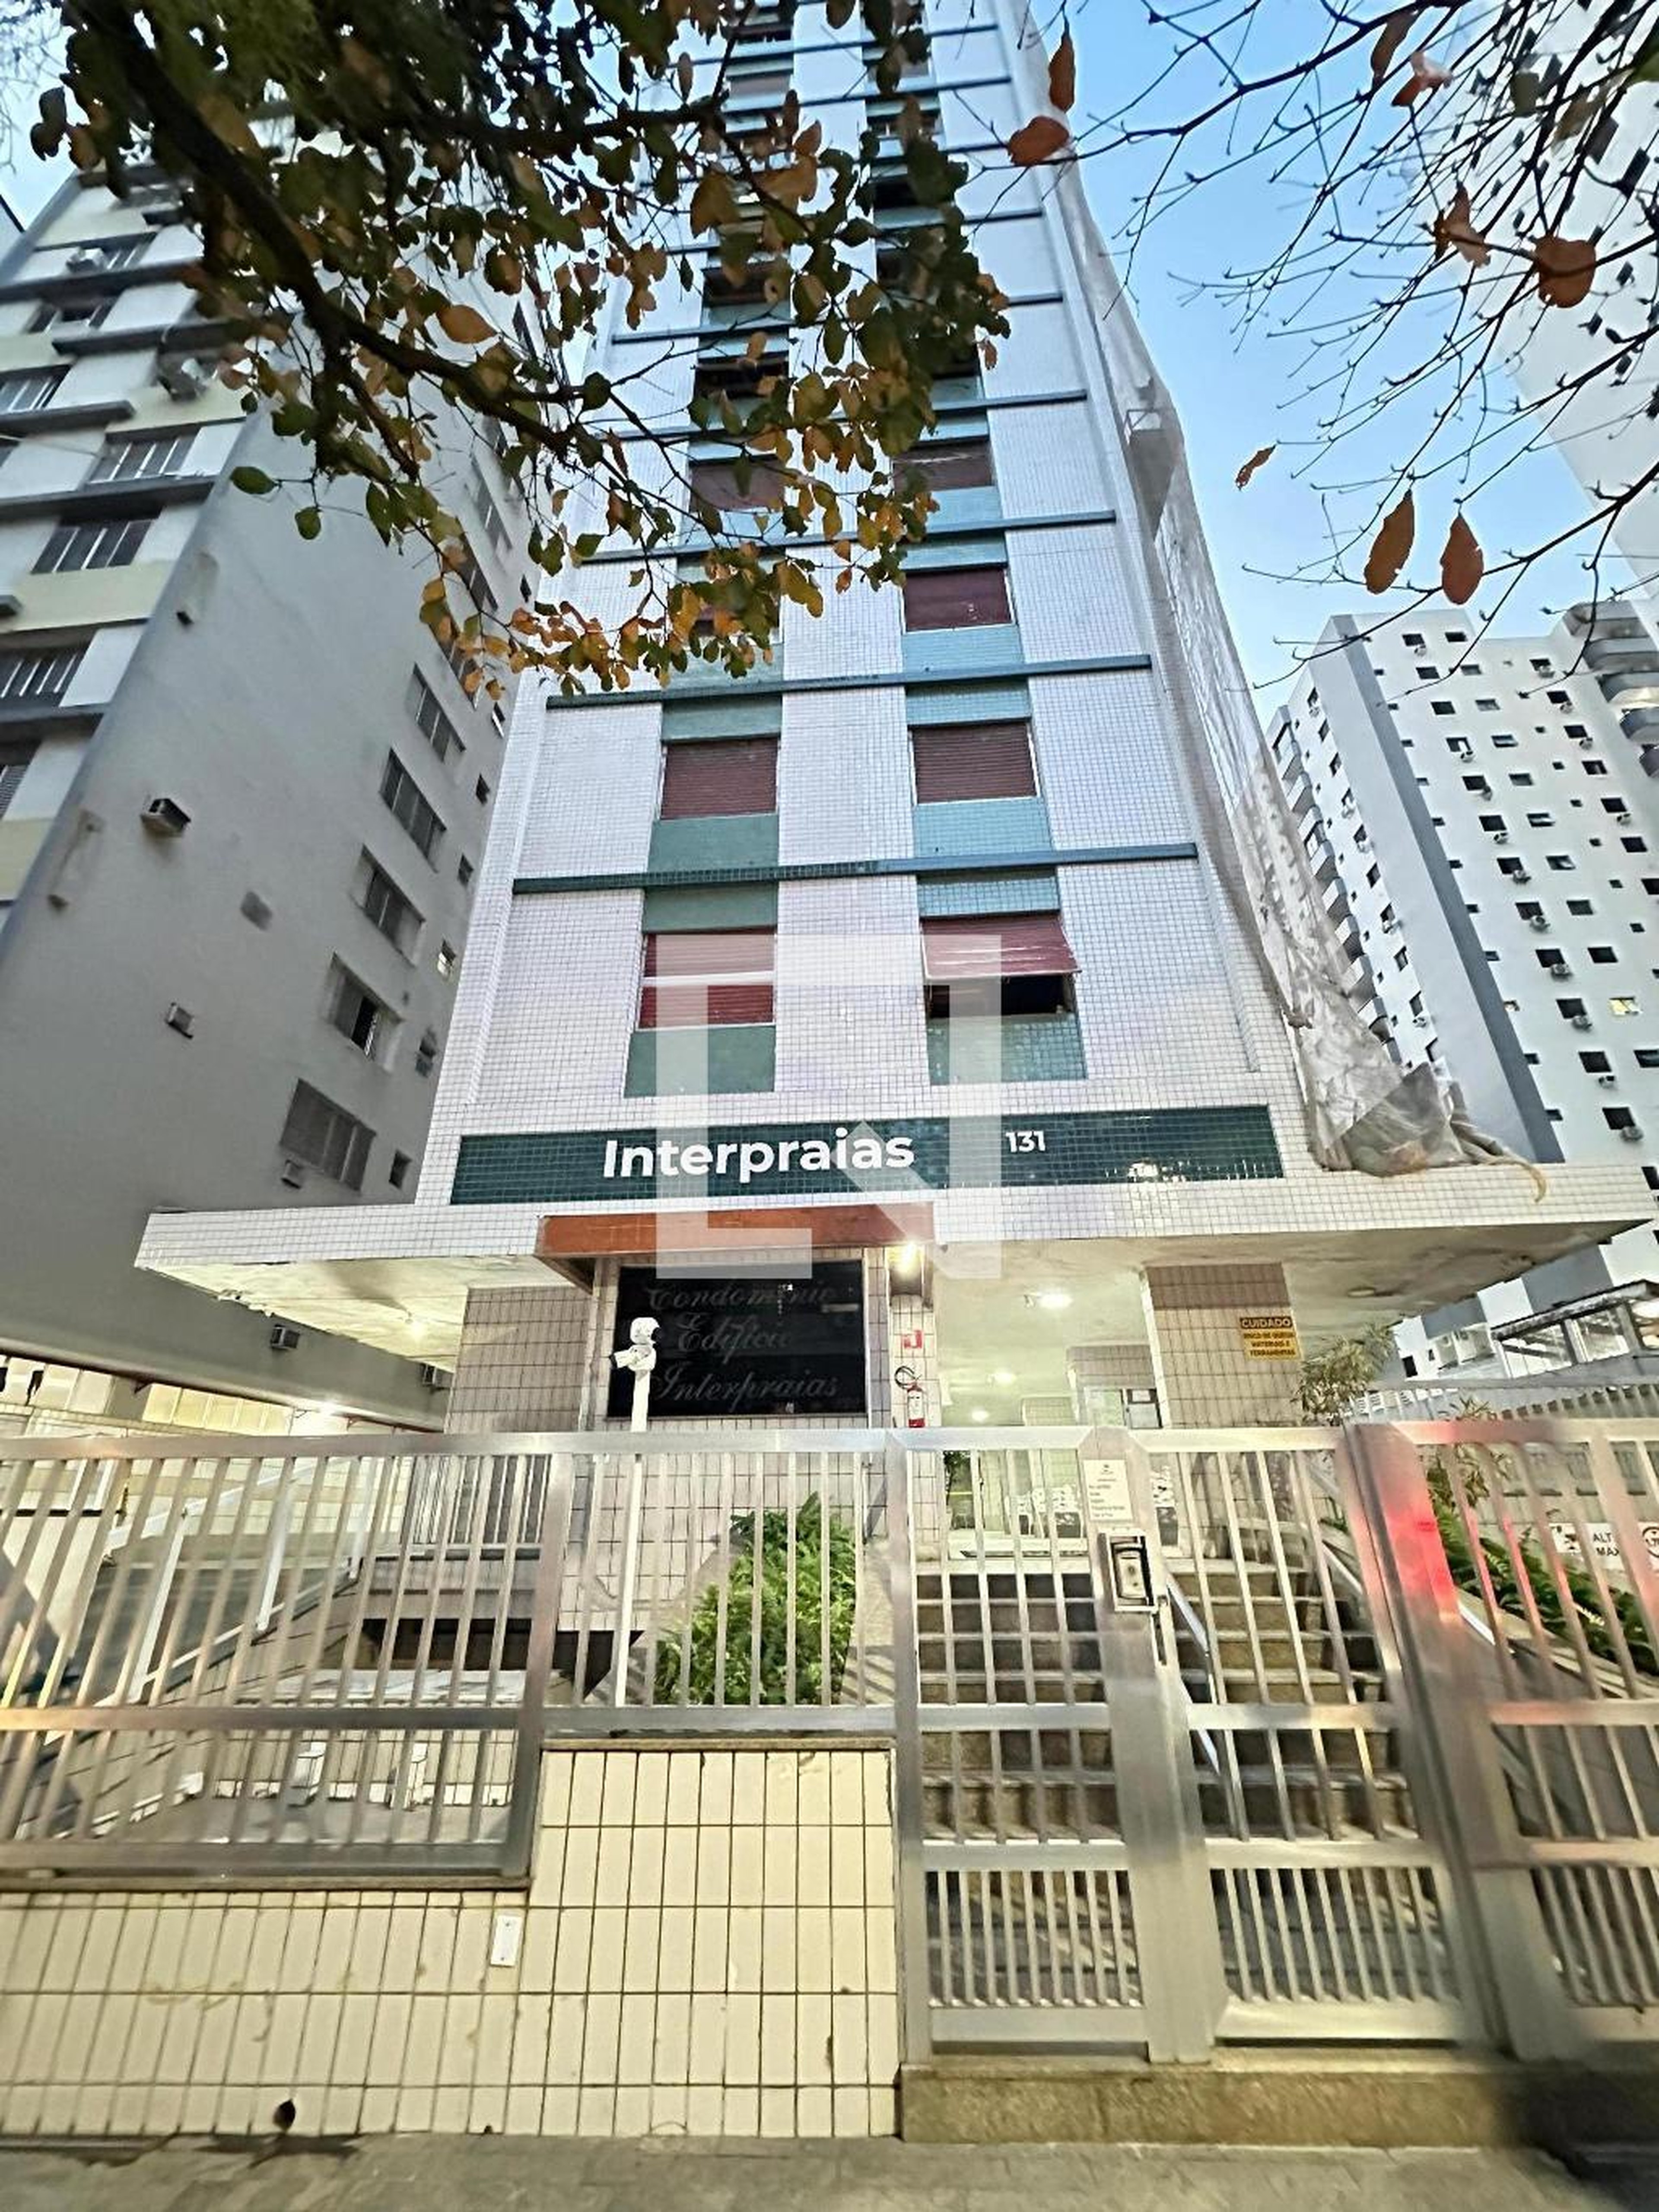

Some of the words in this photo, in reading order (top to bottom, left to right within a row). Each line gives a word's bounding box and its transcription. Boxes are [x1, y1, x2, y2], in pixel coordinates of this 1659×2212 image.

[604, 1127, 915, 1184] Interpraias
[1006, 1130, 1046, 1152] 131
[1242, 1318, 1291, 1327] CUIDADO
